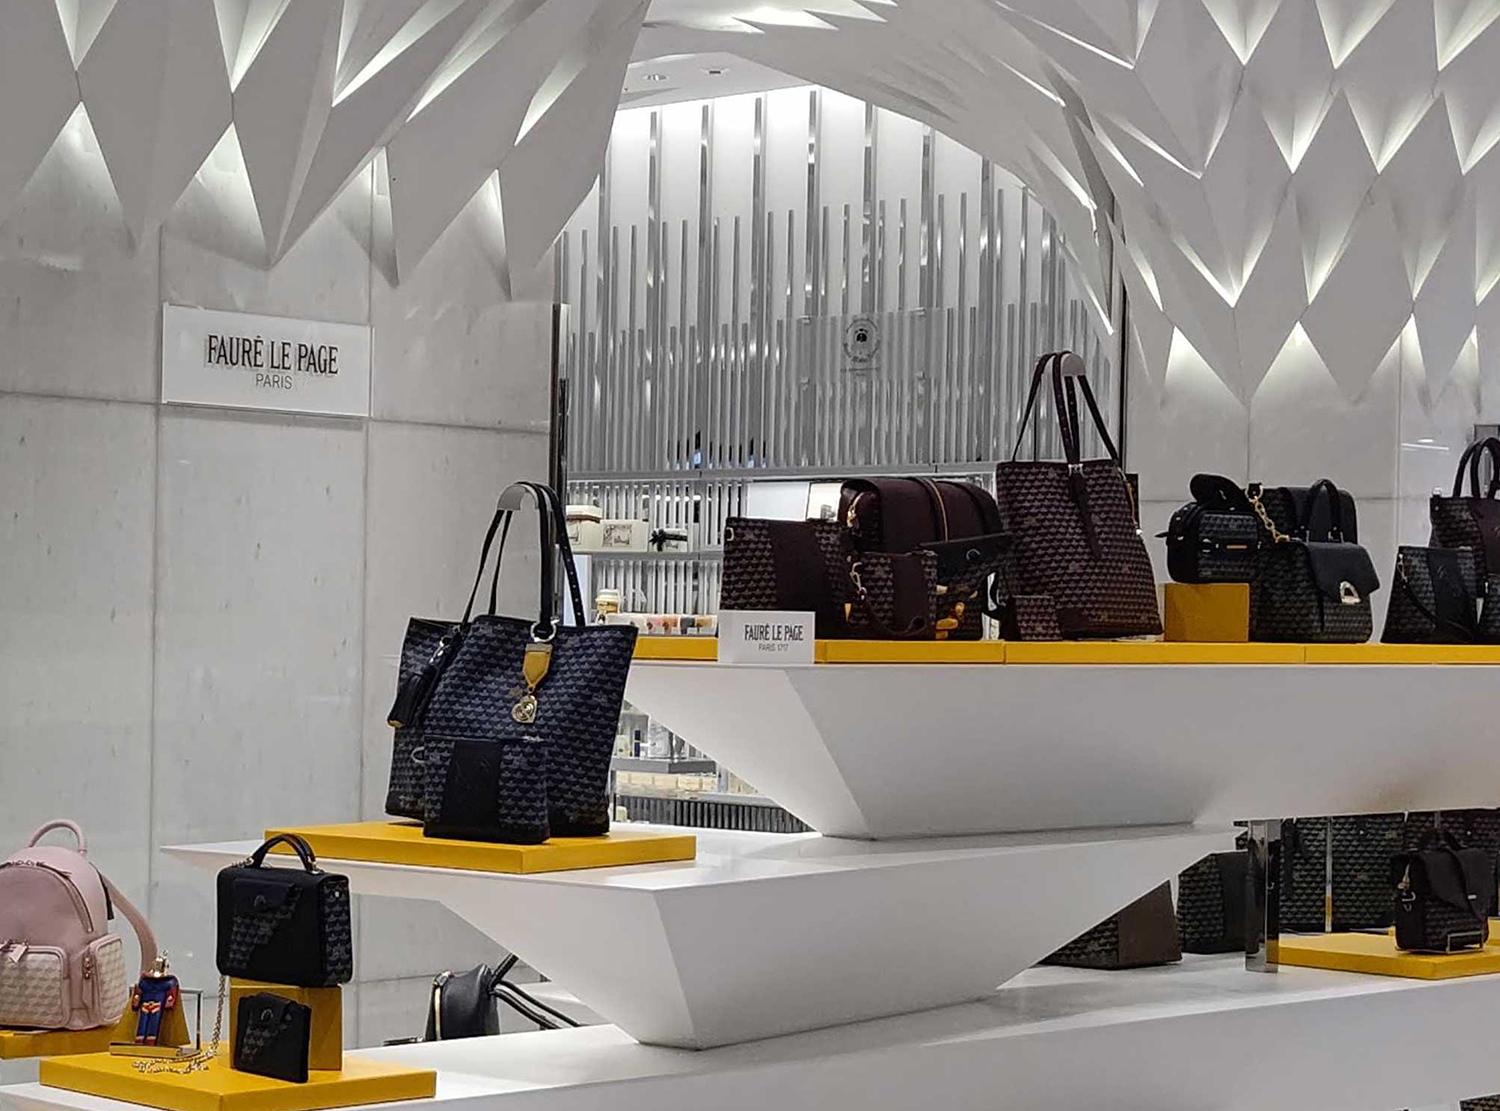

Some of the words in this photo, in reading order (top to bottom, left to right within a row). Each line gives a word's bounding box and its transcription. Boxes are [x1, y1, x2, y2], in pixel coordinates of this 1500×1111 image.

[207, 334, 264, 369] FAURÉ
[269, 341, 291, 371] LE
[297, 343, 339, 375] PAGE
[255, 373, 293, 390] PARIS
[744, 623, 770, 641] FAURÉ
[772, 624, 783, 641] LE
[784, 625, 804, 641] PAGE
[758, 643, 776, 652] PARIS
